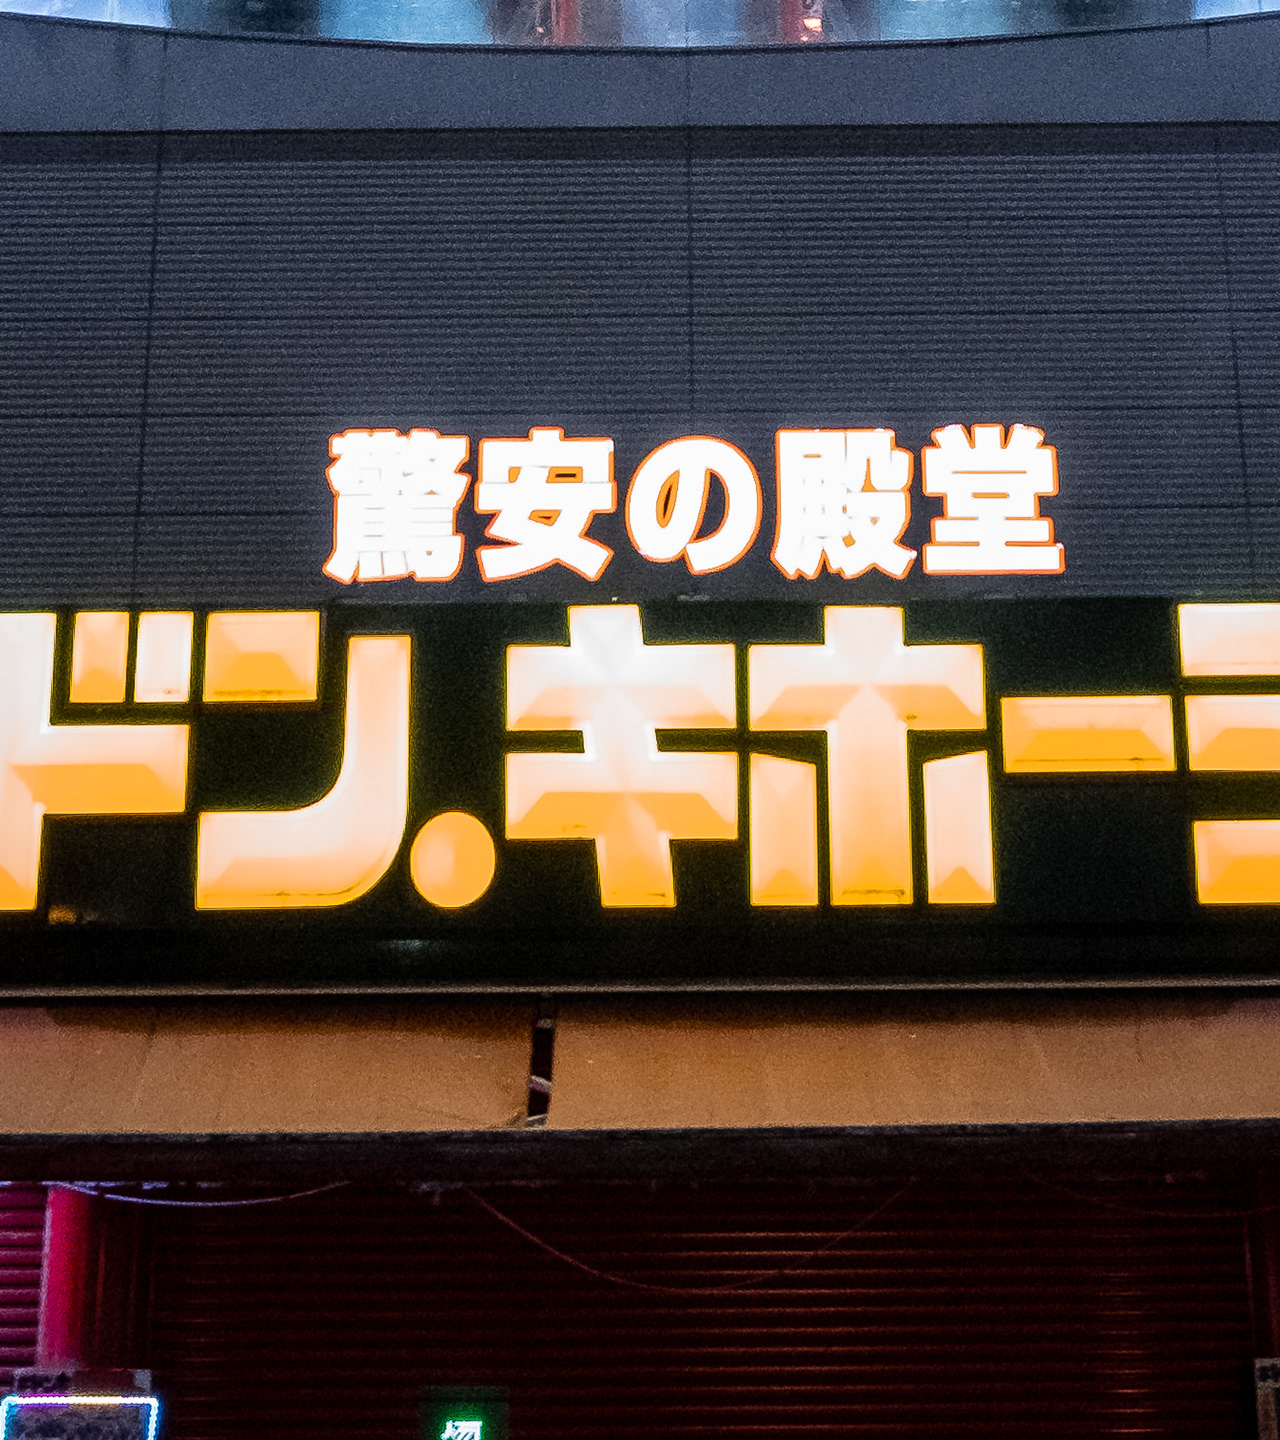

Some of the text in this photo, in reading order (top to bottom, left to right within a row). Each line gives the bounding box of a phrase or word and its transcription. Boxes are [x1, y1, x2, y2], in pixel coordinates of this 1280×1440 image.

[324, 422, 1067, 584] 驚安の殿堂
